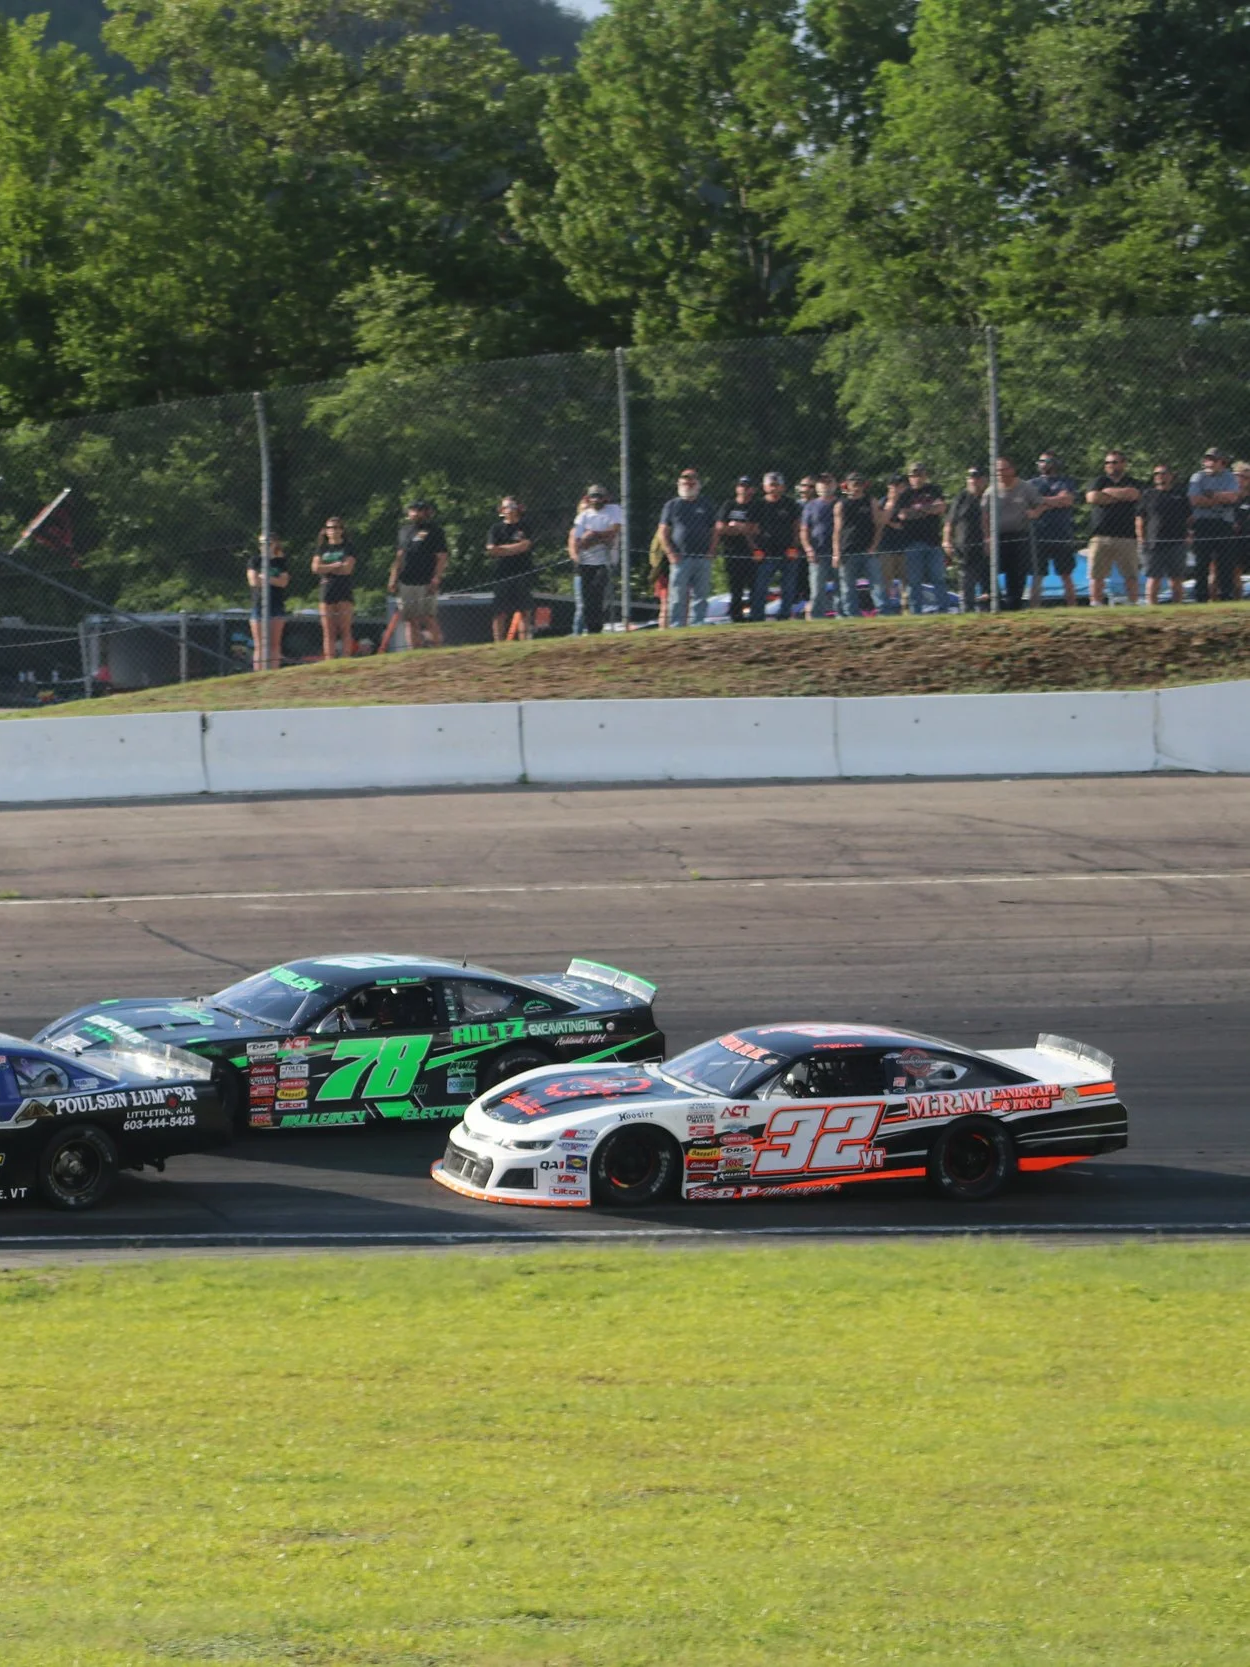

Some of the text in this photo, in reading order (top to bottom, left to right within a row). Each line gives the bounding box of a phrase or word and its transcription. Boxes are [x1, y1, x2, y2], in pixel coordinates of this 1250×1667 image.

[452, 1017, 603, 1044] HILTZ EXCAVATING Inc.
[281, 1036, 311, 1049] ACT
[315, 1034, 434, 1101] 78
[54, 1092, 128, 1116] POULSEN
[906, 1085, 1060, 1120] M.R.M. LANDSCAPE
[1000, 1098, 1051, 1112] & FENCE
[618, 1111, 654, 1122] Hoosier
[720, 1105, 750, 1119] ACT
[123, 1115, 196, 1131] 603-444-5425
[750, 1101, 886, 1174] 32 VT
[540, 1160, 565, 1171] QA1
[10, 1187, 28, 1199] VT
